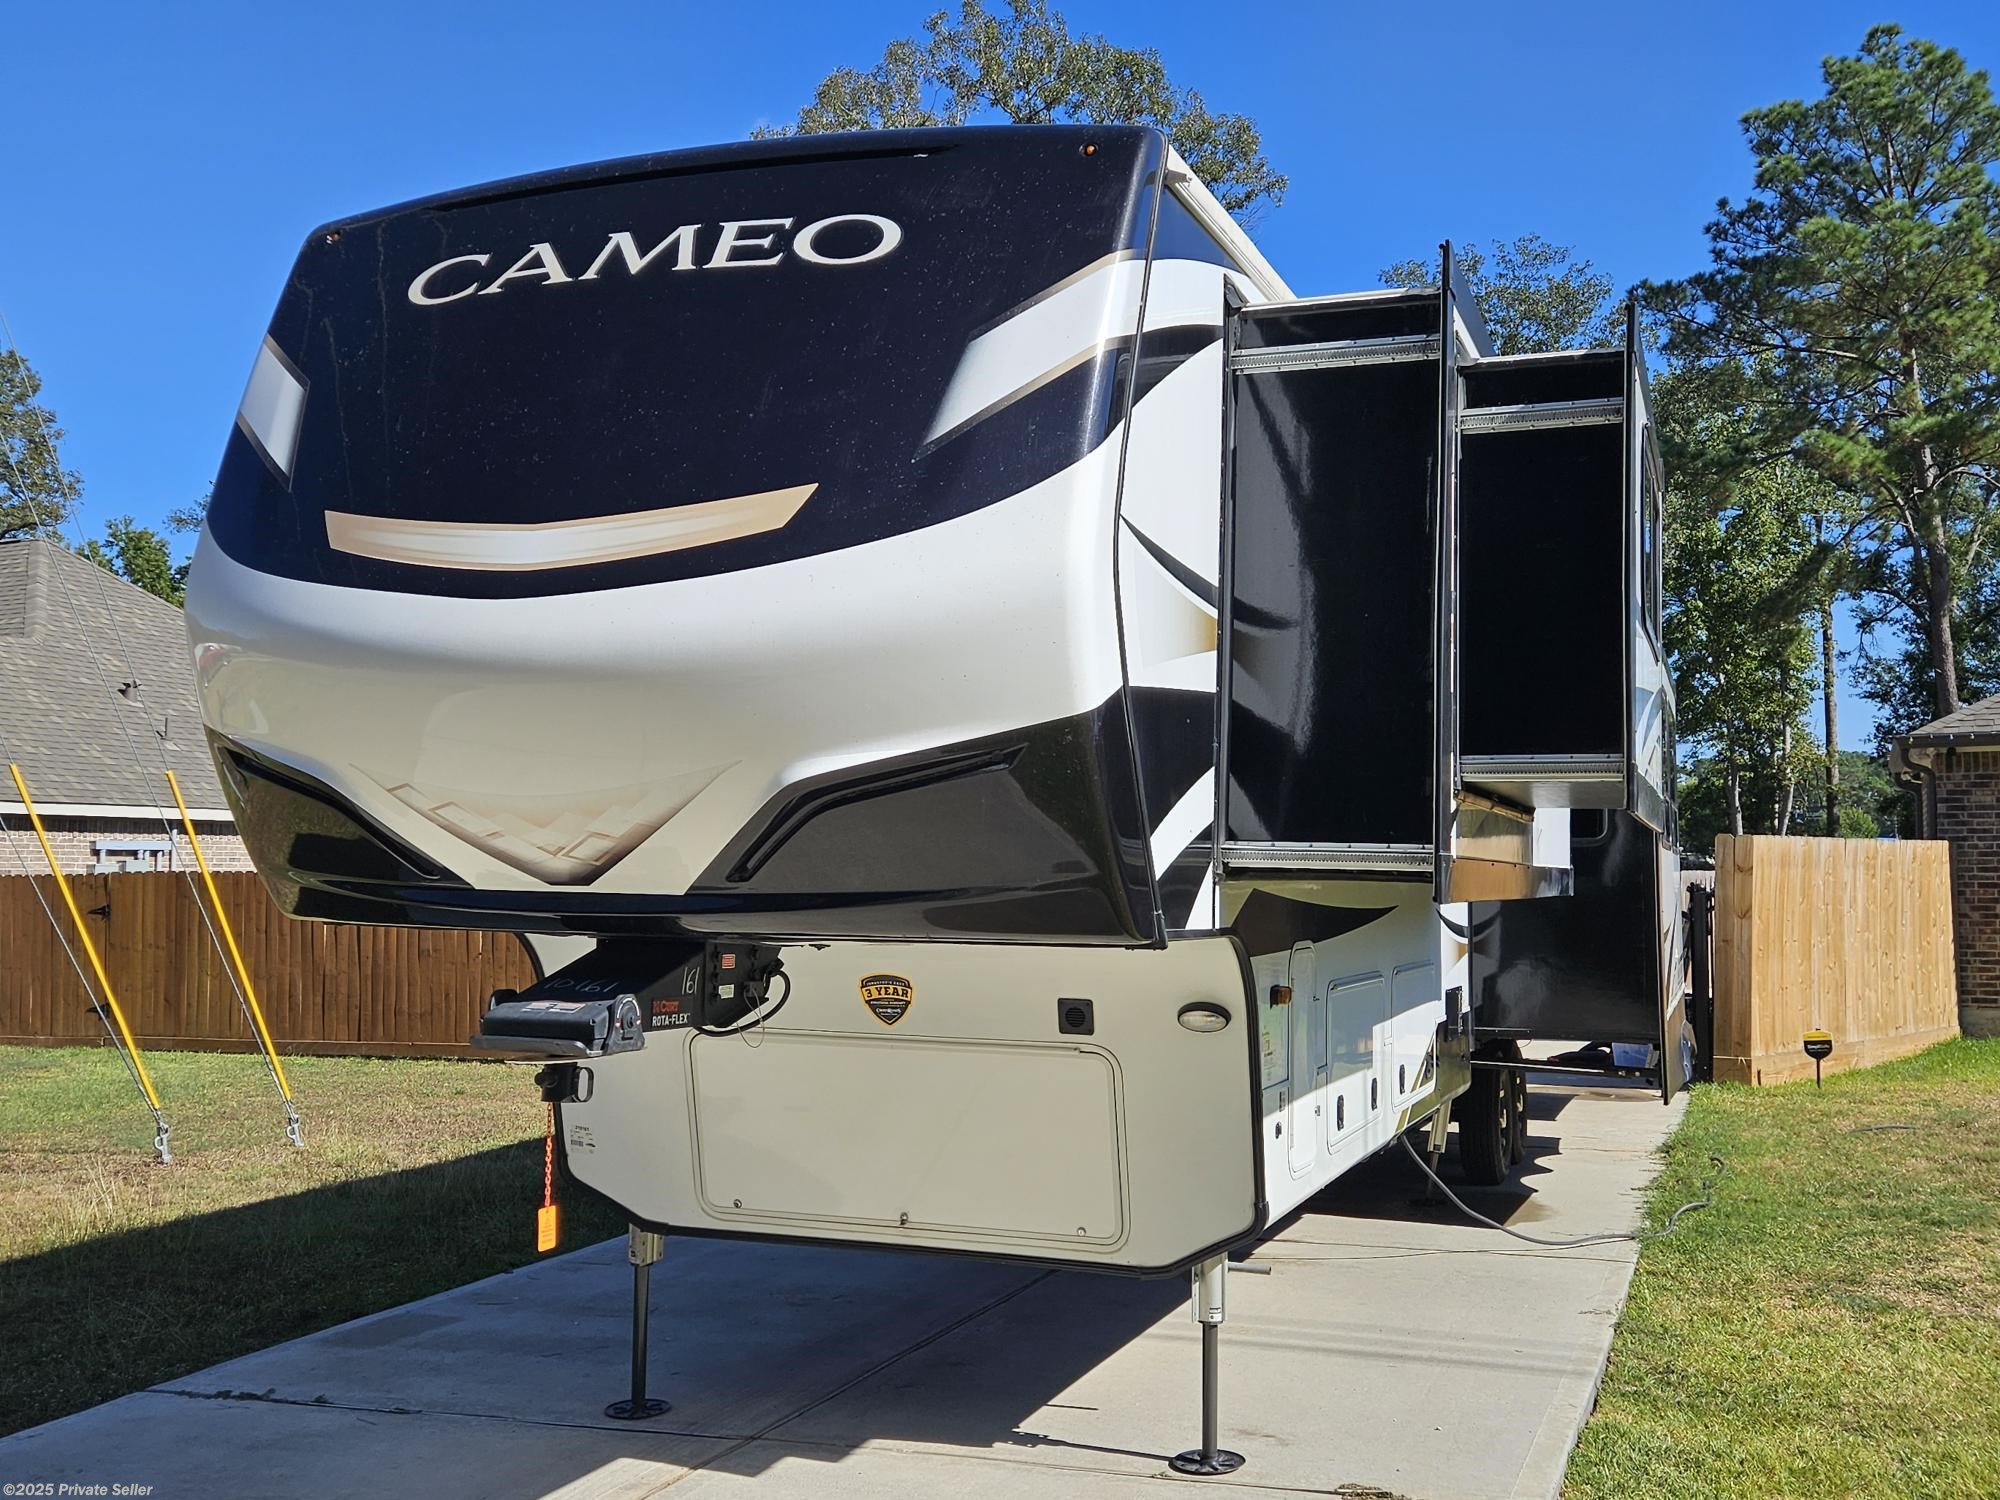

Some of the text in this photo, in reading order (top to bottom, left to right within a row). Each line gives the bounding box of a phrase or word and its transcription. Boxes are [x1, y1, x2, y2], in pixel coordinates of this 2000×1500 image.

[407, 213, 902, 306] CAMEO
[681, 966, 700, 995] 161
[865, 986, 909, 998] 3 YEAR
[652, 1013, 689, 1027] ROTA-FLEX
